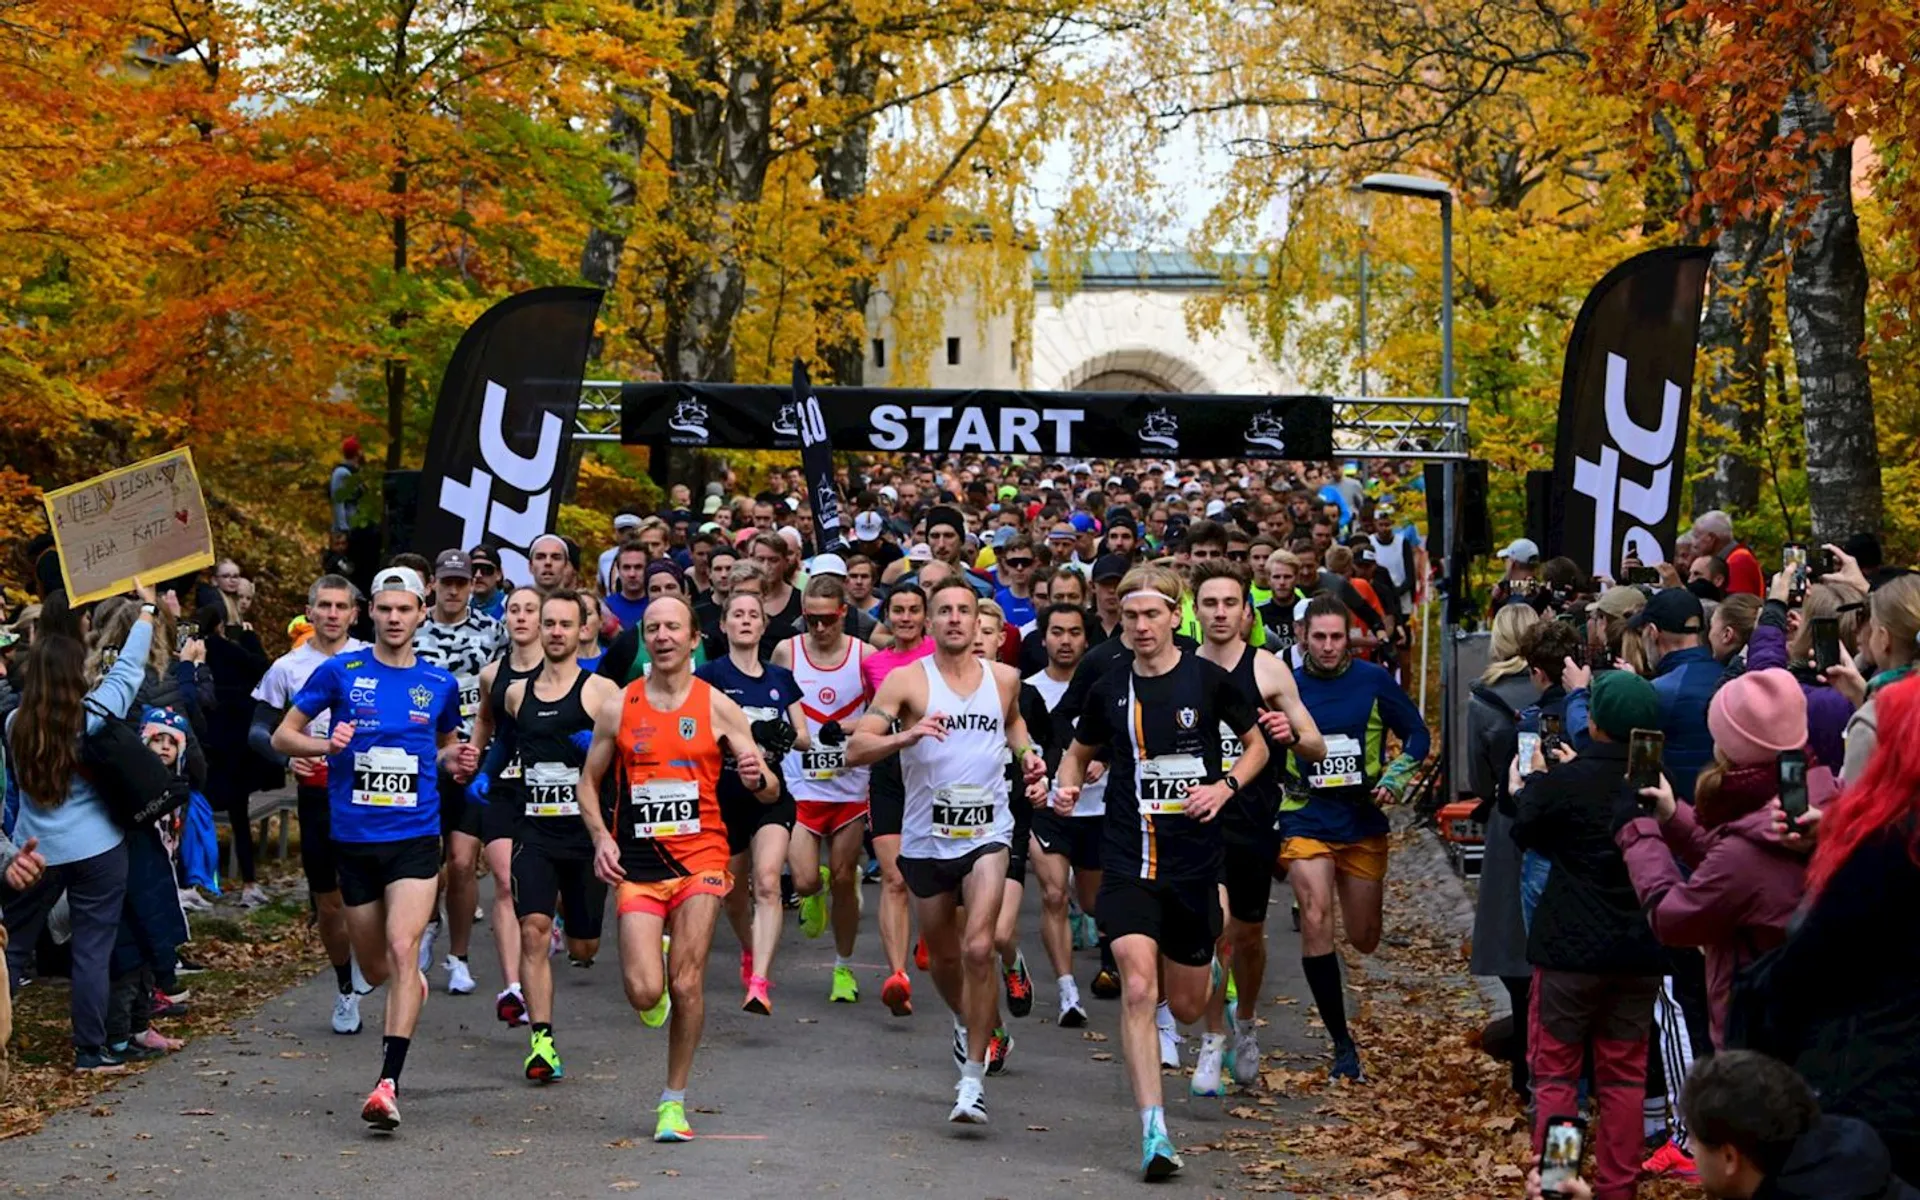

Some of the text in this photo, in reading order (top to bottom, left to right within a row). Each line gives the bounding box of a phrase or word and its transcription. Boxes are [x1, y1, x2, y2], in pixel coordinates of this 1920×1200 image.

[869, 404, 1084, 454] START
[133, 518, 171, 546] KATE
[1276, 624, 1289, 636] 13
[349, 688, 375, 703] ec
[938, 714, 998, 734] ANTRA
[807, 752, 846, 769] 1651
[1312, 756, 1357, 775] 1998
[361, 772, 411, 792] 1460
[530, 785, 574, 803] 1713
[640, 801, 692, 823] 1719
[941, 807, 987, 826] 1740
